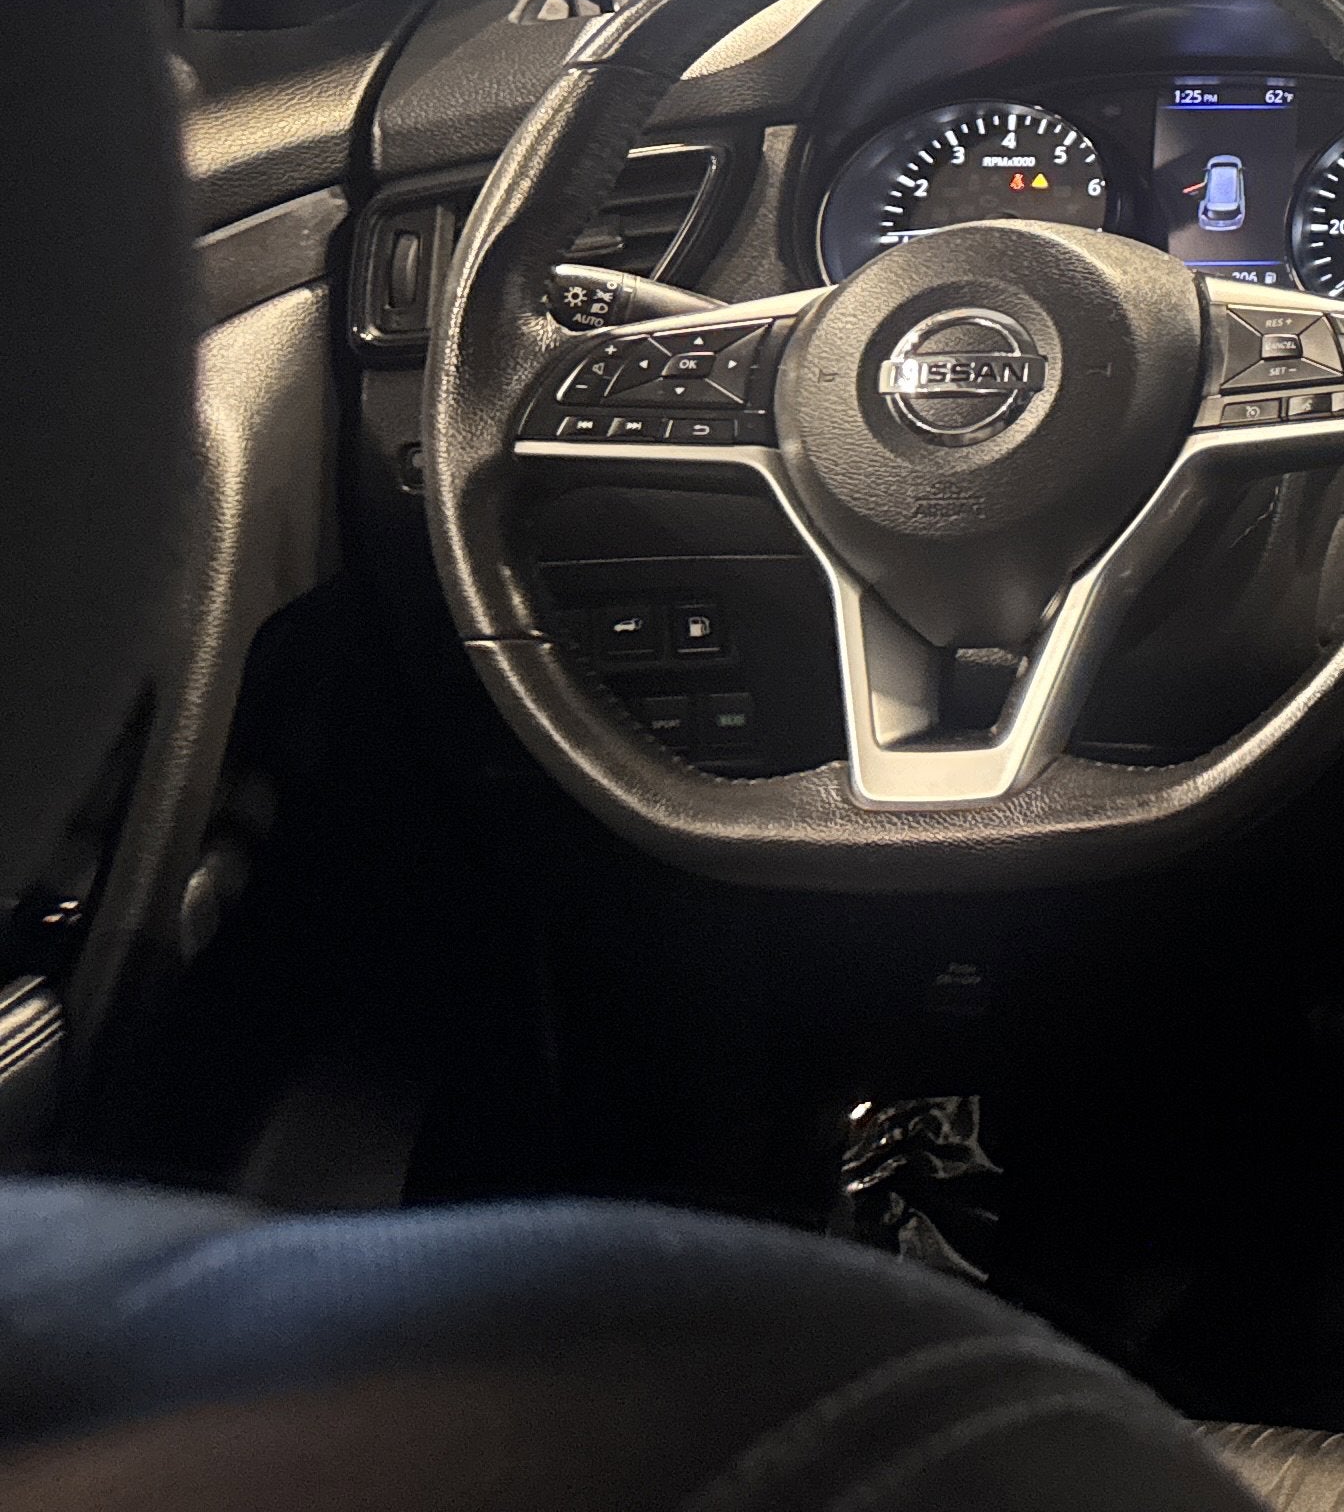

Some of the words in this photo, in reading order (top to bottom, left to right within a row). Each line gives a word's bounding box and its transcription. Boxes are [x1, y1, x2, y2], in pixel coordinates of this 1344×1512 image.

[1174, 89, 1202, 104] 1:25
[1203, 93, 1218, 103] PM
[1001, 132, 1017, 150] 4
[950, 146, 966, 165] 3
[1053, 145, 1068, 165] 5
[913, 178, 929, 197] 2
[1087, 178, 1101, 197] 6
[572, 312, 605, 328] AUTO
[1265, 318, 1284, 328] RES
[678, 359, 698, 370] OK
[1268, 366, 1287, 377] SET
